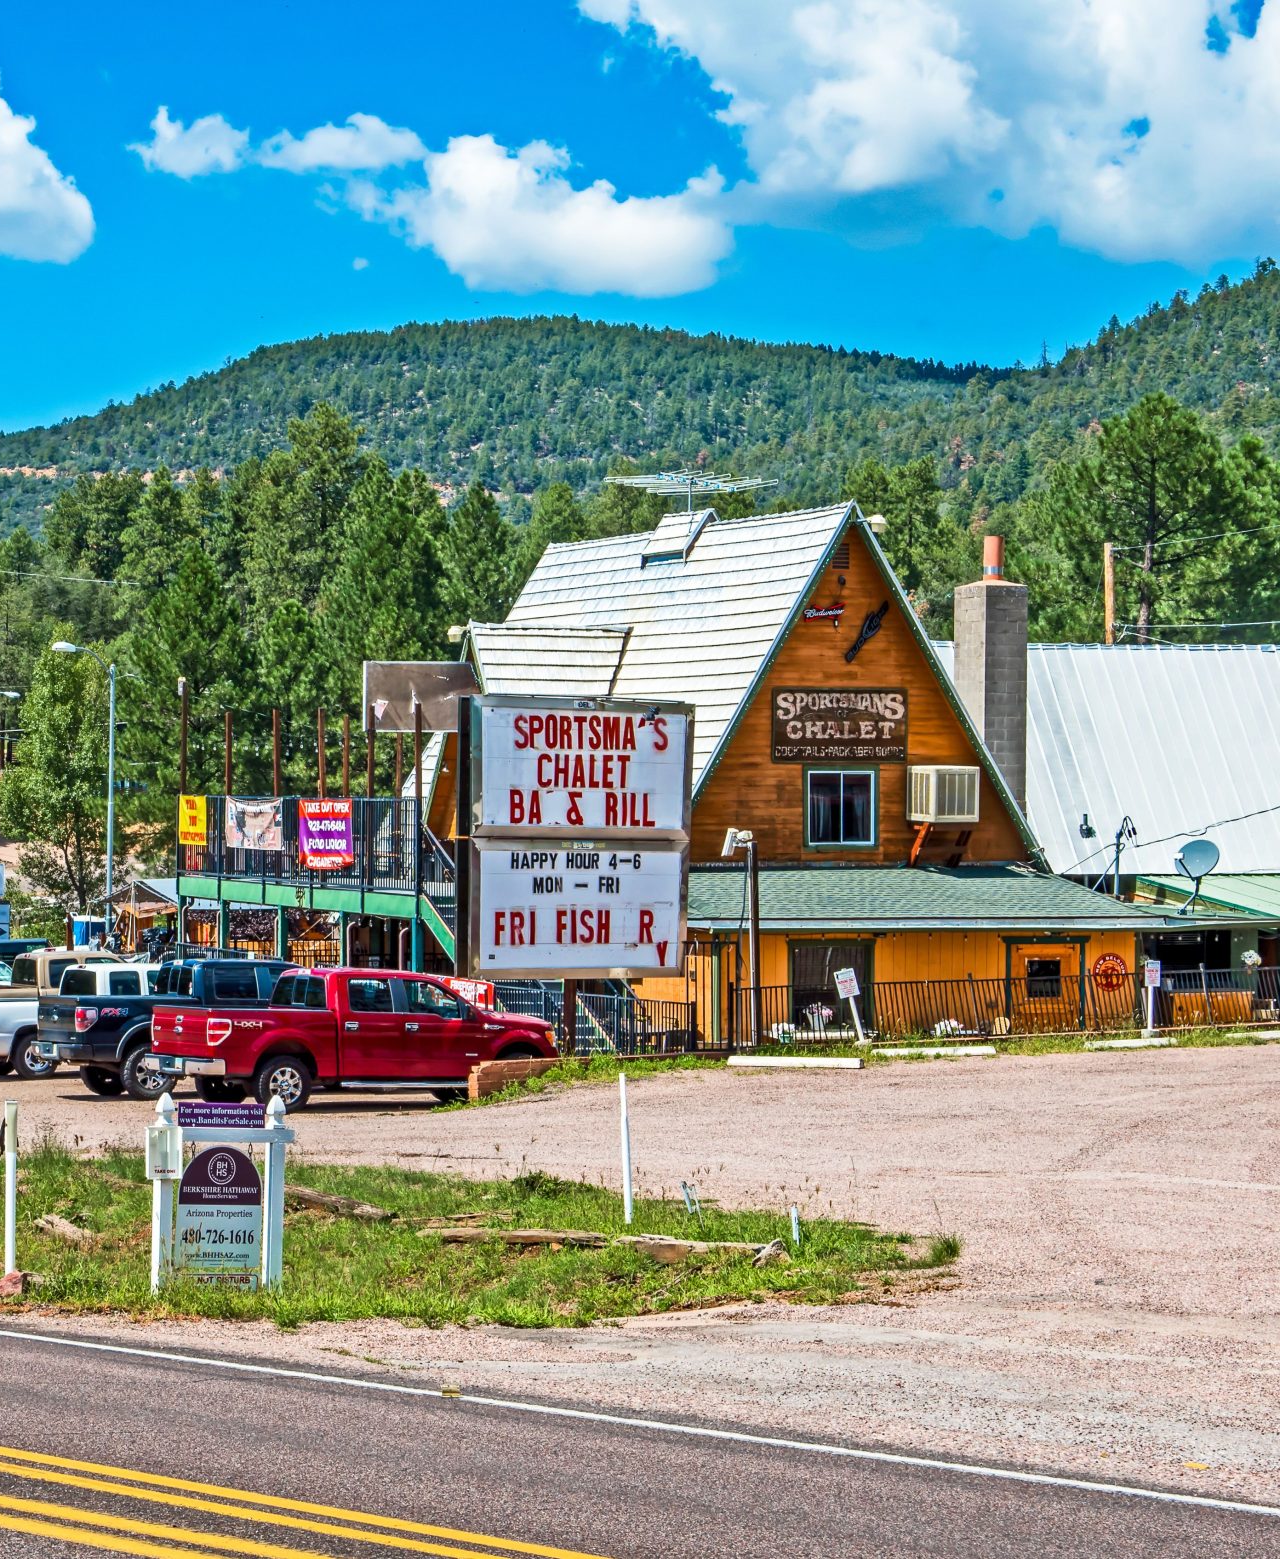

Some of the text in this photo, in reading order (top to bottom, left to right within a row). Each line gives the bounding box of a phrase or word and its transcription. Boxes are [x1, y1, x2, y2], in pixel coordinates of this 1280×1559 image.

[804, 608, 844, 618] Budweiser
[776, 692, 905, 720] SPORTSMANS
[786, 721, 895, 740] CHALET
[537, 753, 631, 789] CHALET
[305, 802, 320, 813] TAKE
[511, 851, 558, 870] HAPPY
[566, 852, 600, 870] HOUR
[533, 876, 563, 894] MON
[598, 876, 620, 894] FRI
[494, 910, 536, 947] FRI
[556, 909, 611, 945] FISH
[1095, 959, 1104, 973] NEW
[234, 1020, 263, 1028] 4X4
[180, 1106, 192, 1114] For
[212, 1107, 249, 1115] information
[179, 1116, 264, 1125] www.BanditsForSale.com
[216, 1161, 228, 1169] BH
[216, 1169, 228, 1177] HS
[222, 1186, 258, 1194] HATHAWAY
[186, 1208, 253, 1219] Arizona Properties
[182, 1228, 255, 1245] 480-726-1616
